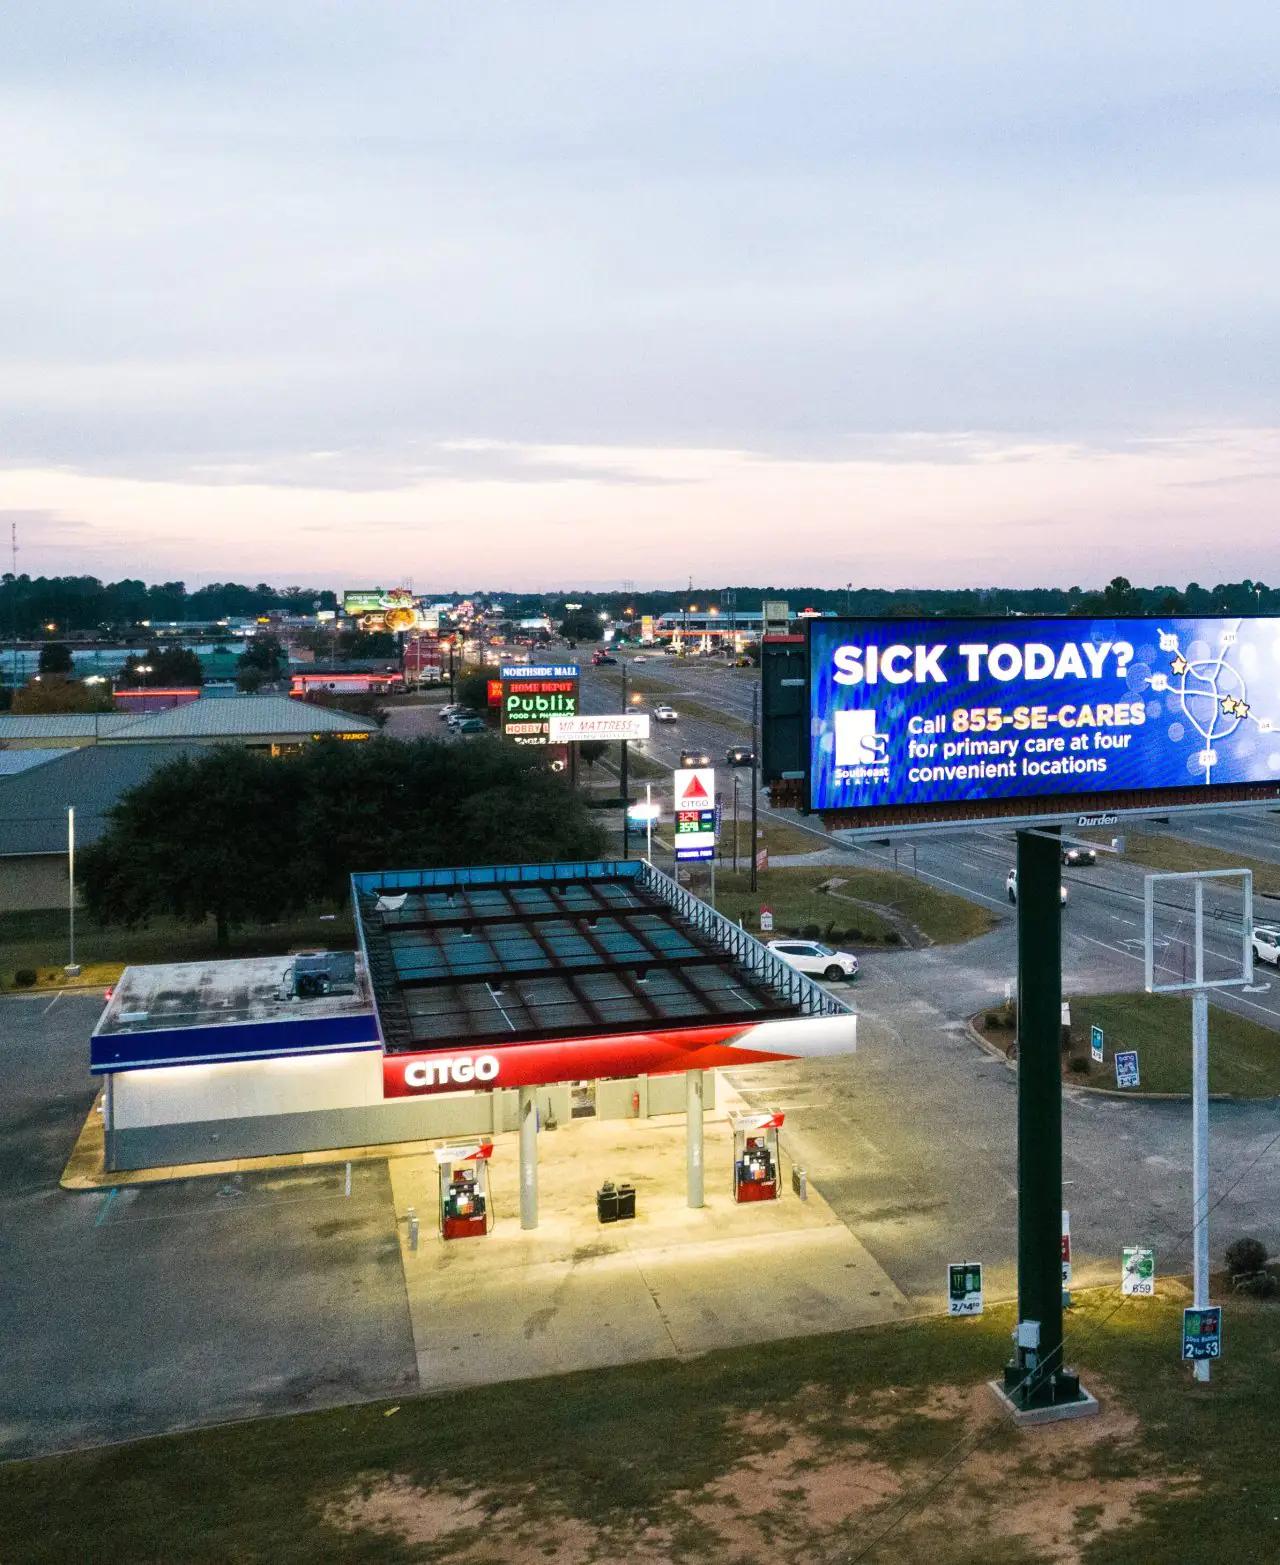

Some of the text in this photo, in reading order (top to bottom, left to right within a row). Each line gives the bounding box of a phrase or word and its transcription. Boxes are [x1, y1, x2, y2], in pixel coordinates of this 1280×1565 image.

[833, 642, 1134, 685] SICK TODAY?
[503, 667, 578, 677] NORTHSIDE MALL
[510, 683, 540, 693] HOME
[542, 682, 573, 692] DEPOT
[507, 695, 575, 711] Publix
[580, 720, 632, 731] MATTRESS
[908, 703, 1146, 734] Call 855-SE-CARES
[506, 723, 541, 733] HOBBY
[908, 732, 1131, 759] for primary care at four
[835, 767, 889, 778] Southeast
[908, 756, 1107, 782] convenient locations
[835, 778, 889, 786] HEALTH
[1078, 814, 1117, 827] Durden
[404, 1055, 500, 1087] CITGO
[1185, 1343, 1195, 1358] 2
